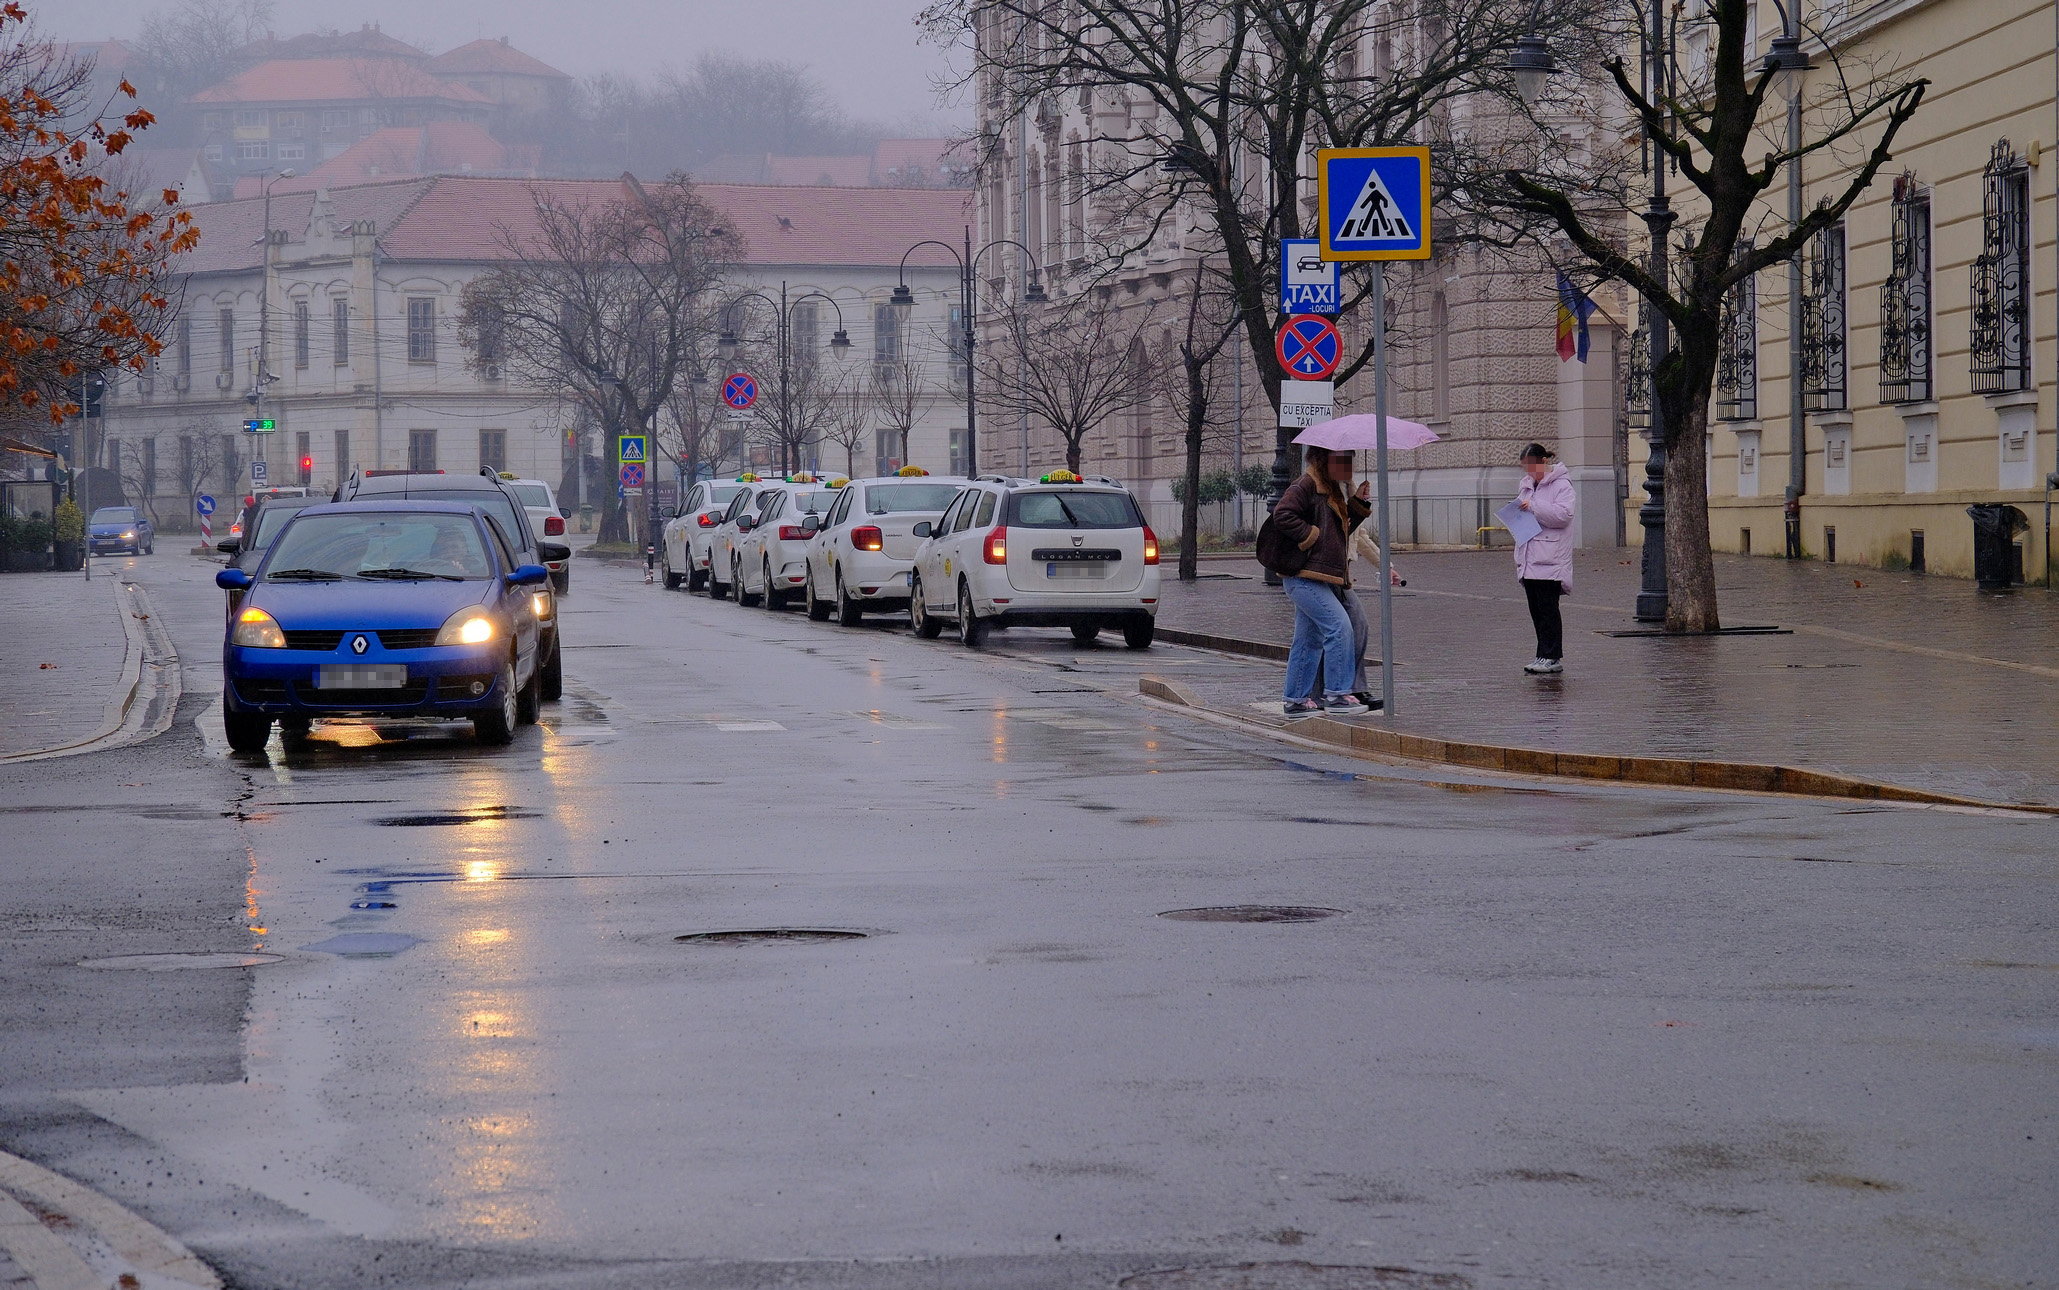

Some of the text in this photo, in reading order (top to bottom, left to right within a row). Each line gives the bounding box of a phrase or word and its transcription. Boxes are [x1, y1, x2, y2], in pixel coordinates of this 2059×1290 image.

[1287, 284, 1334, 303] TAXI
[1282, 405, 1331, 416] CU EXCEPTIA
[263, 421, 272, 429] 39
[1296, 417, 1313, 427] TAXI
